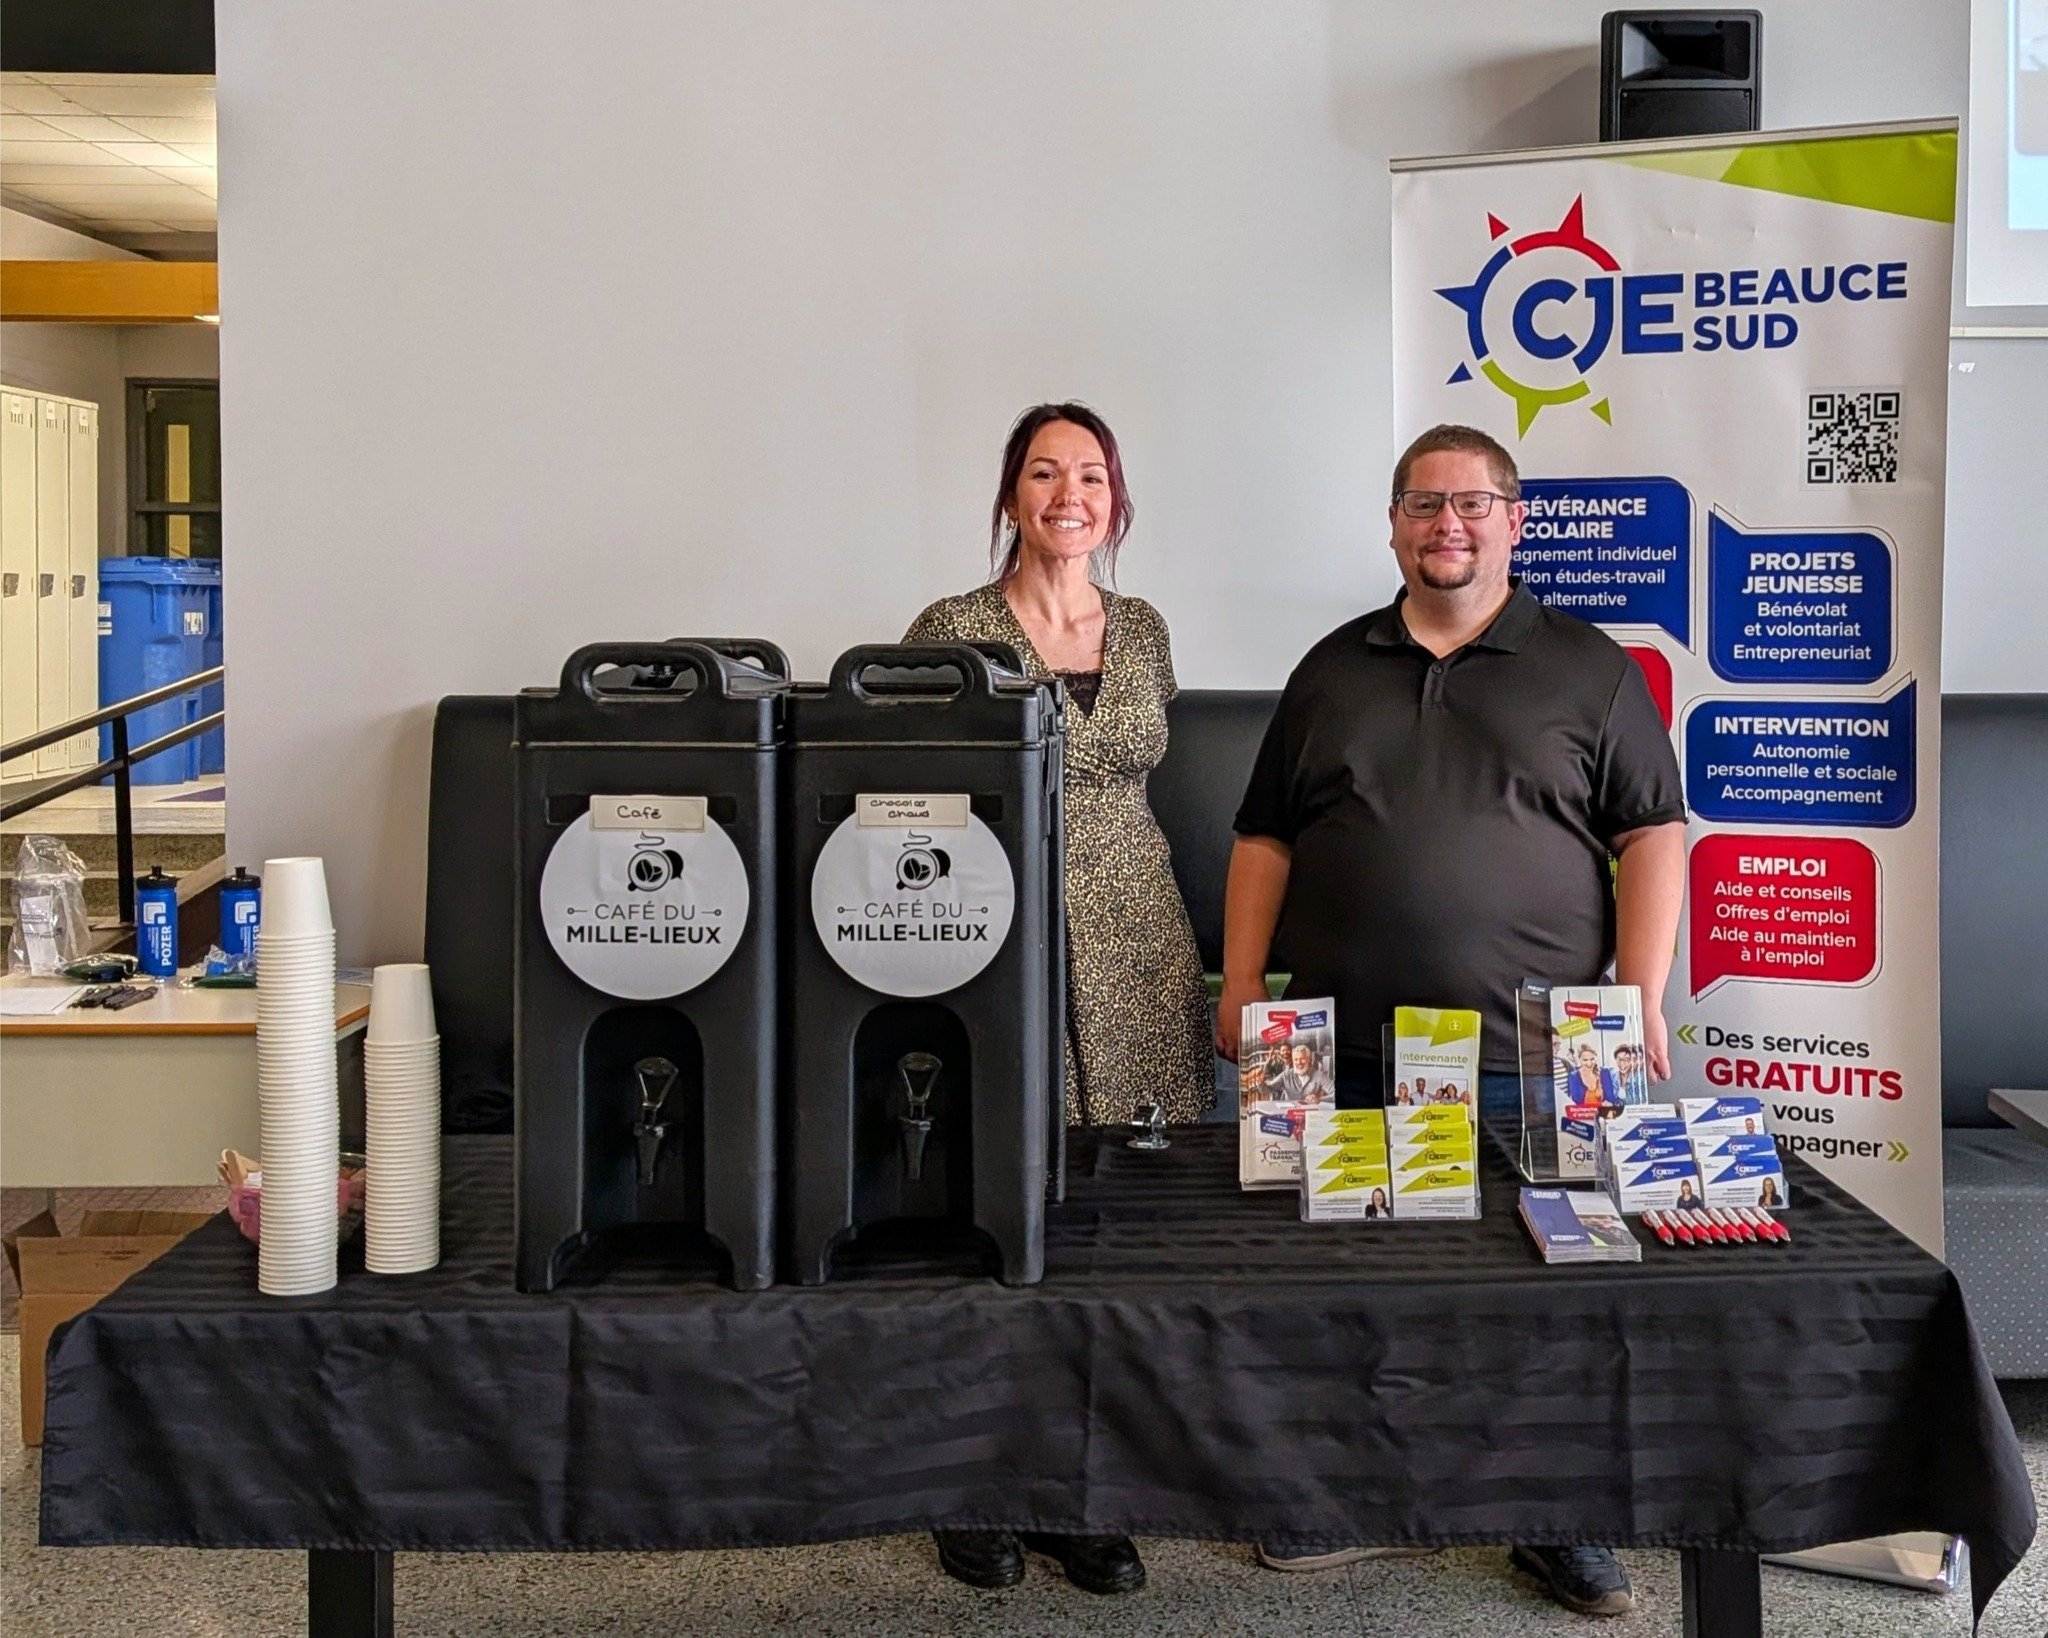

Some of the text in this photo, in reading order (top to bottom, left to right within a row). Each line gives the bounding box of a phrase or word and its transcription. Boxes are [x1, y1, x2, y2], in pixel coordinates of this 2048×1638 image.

[1693, 262, 1908, 308] BEAUCE
[1512, 273, 1684, 373] CJE
[1692, 313, 1799, 351] SUD
[1521, 521, 1614, 539] COLAIRE
[1512, 546, 1677, 565] agnement individuel
[1750, 552, 1856, 571] PROJETS
[1555, 568, 1666, 584] études-travail
[1742, 575, 1863, 594] JEUNESSE
[1542, 591, 1627, 606] alternative
[1757, 601, 1848, 617] Bénévolat
[1744, 622, 1861, 637] et volontariat
[1733, 644, 1872, 662] Entrepreneuriat
[1714, 716, 1889, 737] INTERVENTION
[1752, 743, 1851, 760] Autonomie
[1707, 763, 1898, 781] personnelle et sociale
[1721, 784, 1883, 805] Accompagnement
[616, 805, 662, 819] Café
[1738, 856, 1826, 877] EMPLOI
[1713, 881, 1852, 901] Aide et conseils
[594, 901, 696, 920] CAFÉ DU
[864, 899, 962, 918] CAFÉ DU
[1716, 903, 1850, 926] Offres d'emploi
[566, 926, 722, 944] MILLE-LIEUX
[837, 924, 988, 941] MILLE-LIEUX
[1709, 926, 1857, 947] Aide au maintien
[161, 925, 172, 966] POZER
[1740, 946, 1824, 967] à l'emploi
[1705, 1026, 1870, 1058] Des services
[1399, 1051, 1469, 1064] Intervenante
[1704, 1057, 1904, 1101] GRATUITS
[1772, 1104, 1835, 1124] vous
